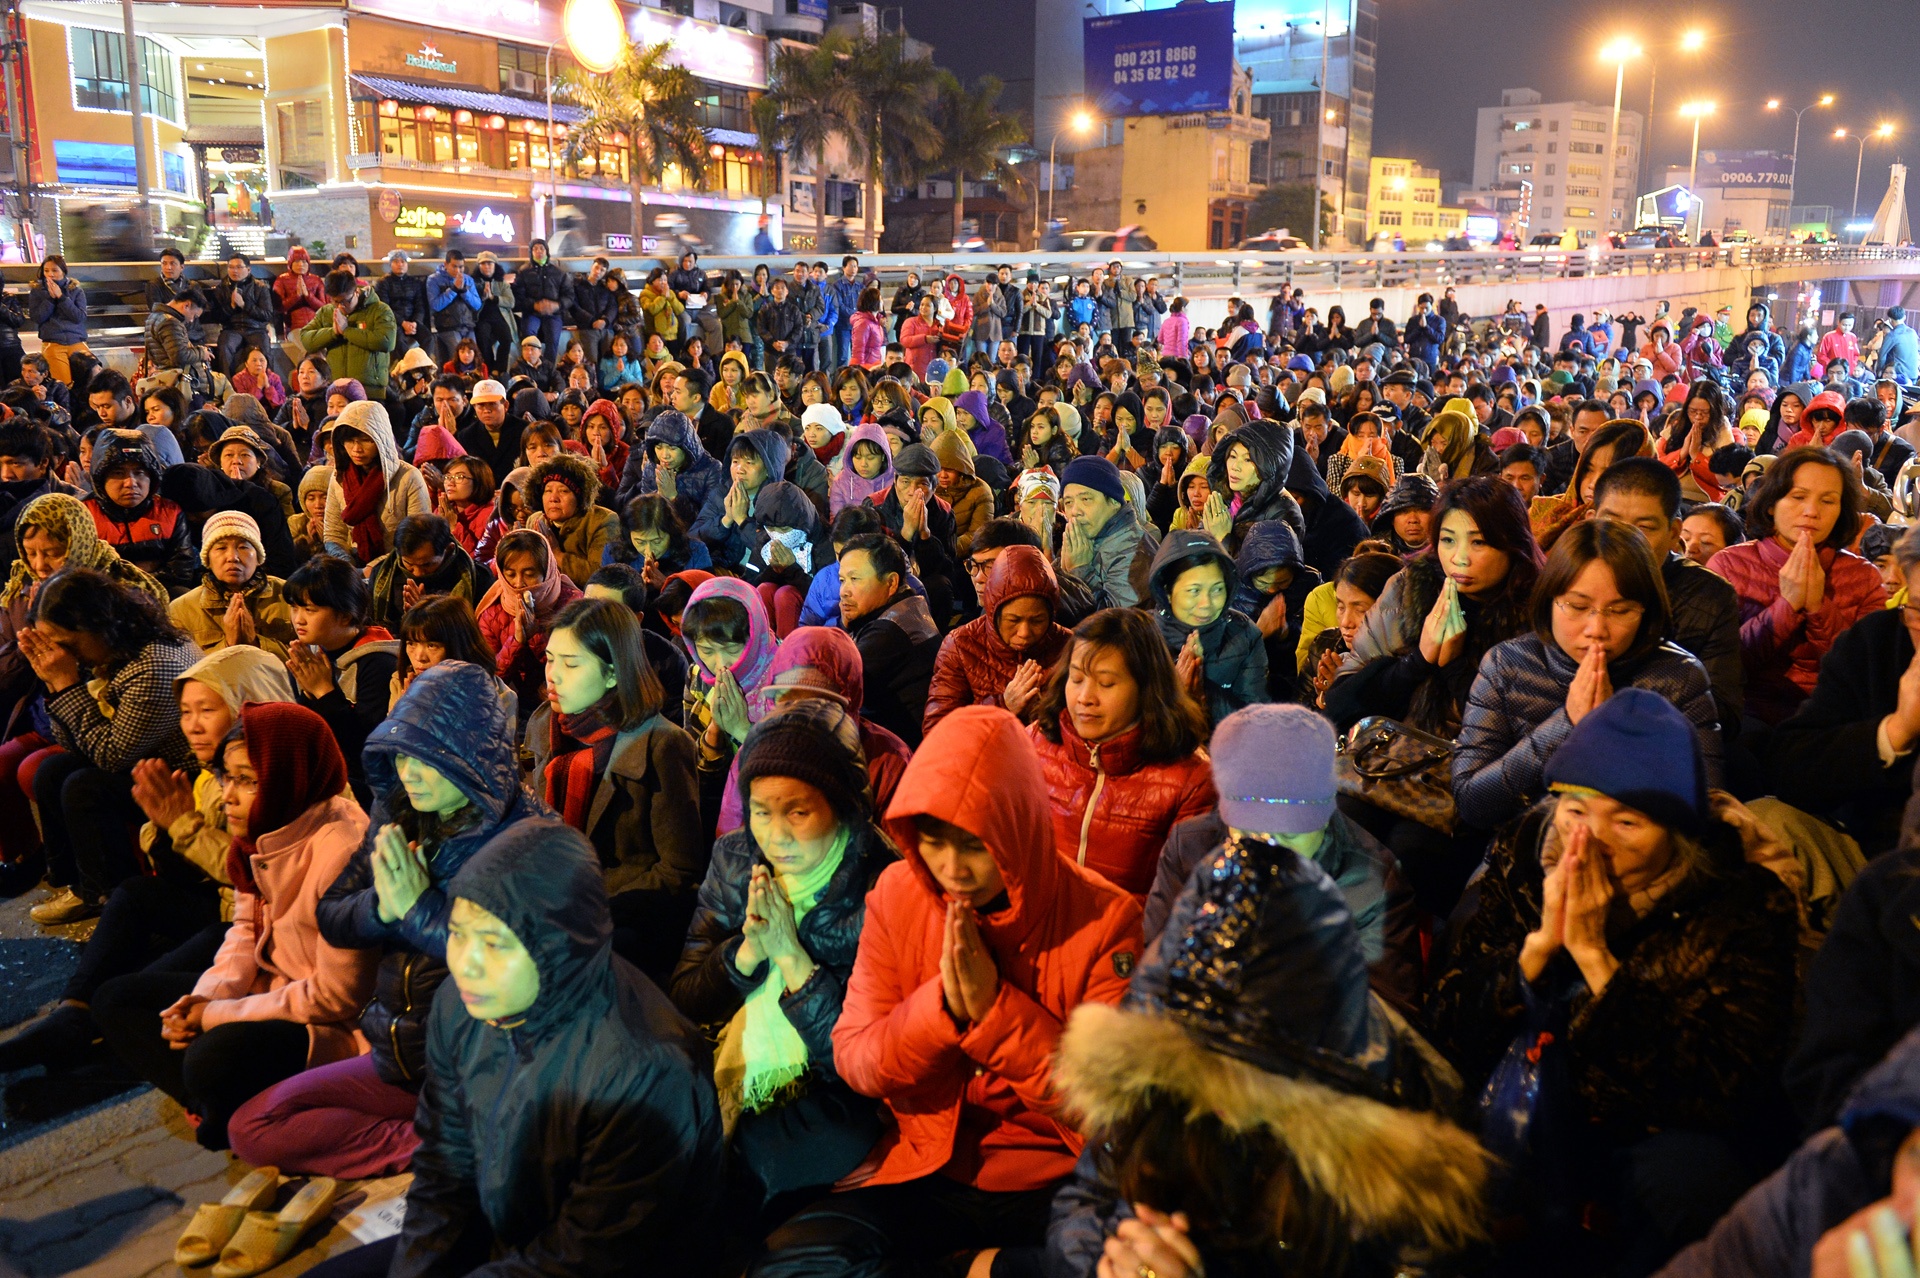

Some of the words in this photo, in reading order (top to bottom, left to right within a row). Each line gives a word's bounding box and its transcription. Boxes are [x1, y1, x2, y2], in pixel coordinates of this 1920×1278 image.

[405, 53, 456, 74] Heineken
[1115, 52, 1137, 67] 090
[1140, 49, 1161, 64] 231
[1166, 45, 1197, 62] 8866
[1114, 70, 1128, 84] 04
[1130, 68, 1145, 82] 35
[1147, 67, 1162, 81] 62
[1164, 65, 1179, 79] 62
[1181, 63, 1196, 77] 42
[608, 237, 658, 249] DIAMND
